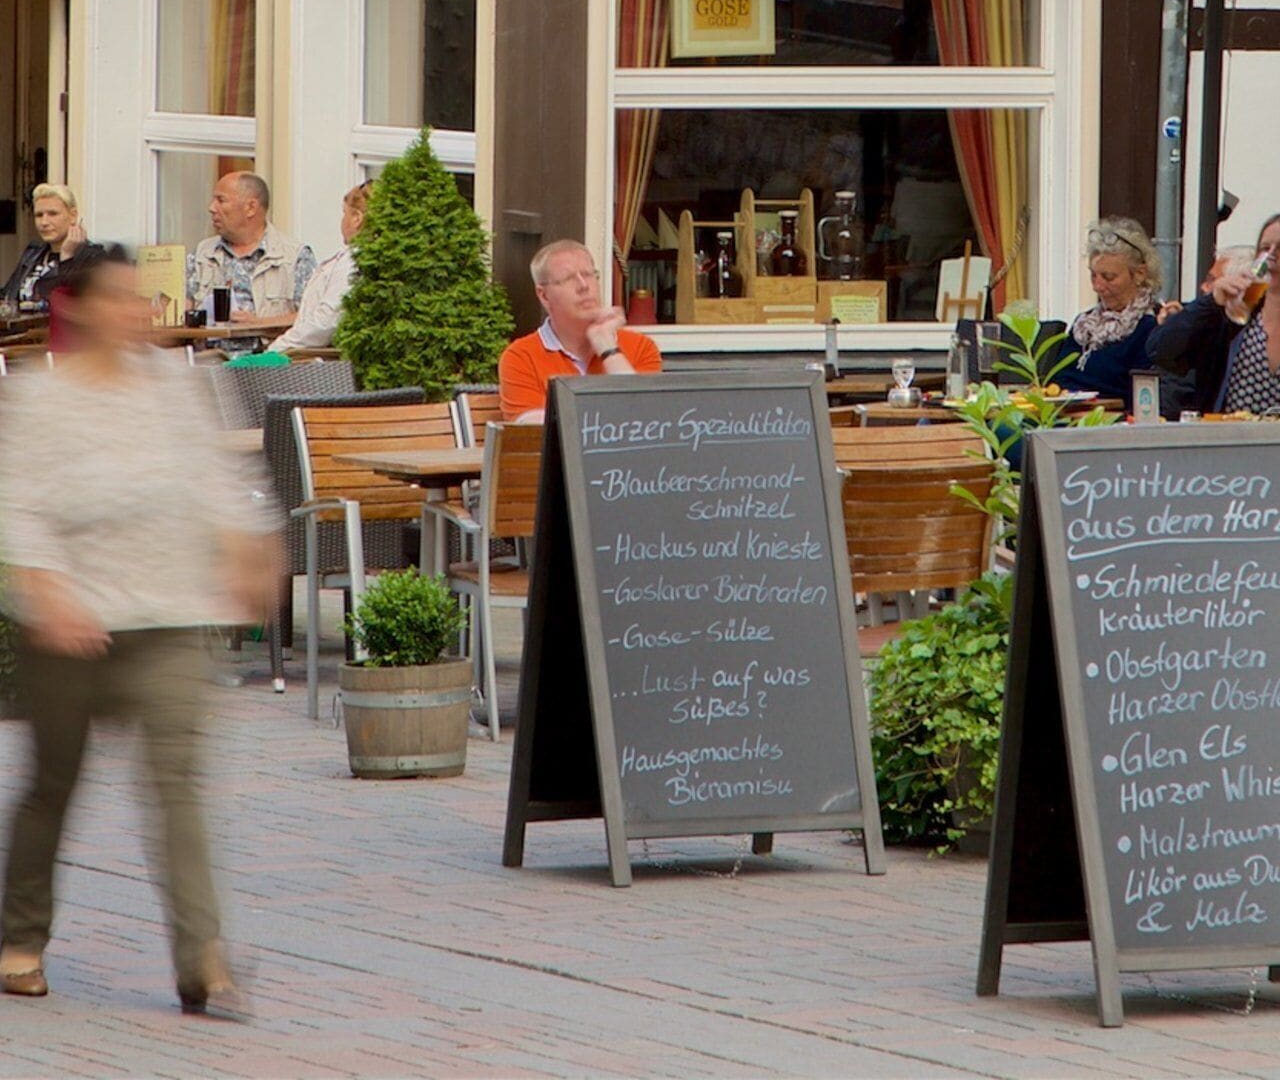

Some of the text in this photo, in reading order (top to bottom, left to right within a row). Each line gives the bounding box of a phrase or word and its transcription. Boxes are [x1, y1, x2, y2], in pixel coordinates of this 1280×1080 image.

[581, 411, 671, 448] Harzer
[1060, 461, 1272, 518] Spirituosen
[1067, 514, 1137, 543] aus
[1145, 503, 1214, 536] dem
[701, 532, 739, 558] und
[745, 528, 823, 561] Knieste
[712, 572, 829, 606] Bierbraten
[711, 659, 759, 700] auf
[763, 667, 812, 687] was
[1105, 636, 1268, 692] Obstgarten
[1107, 689, 1206, 726] Harzer
[620, 733, 785, 779] Hausgemachtes
[1119, 731, 1188, 776] Glen
[665, 767, 794, 806] Bieramisu
[1119, 779, 1212, 814] Harzer
[1124, 865, 1187, 906] Likör
[1192, 867, 1242, 892] aus
[1135, 890, 1269, 933] & Malz
